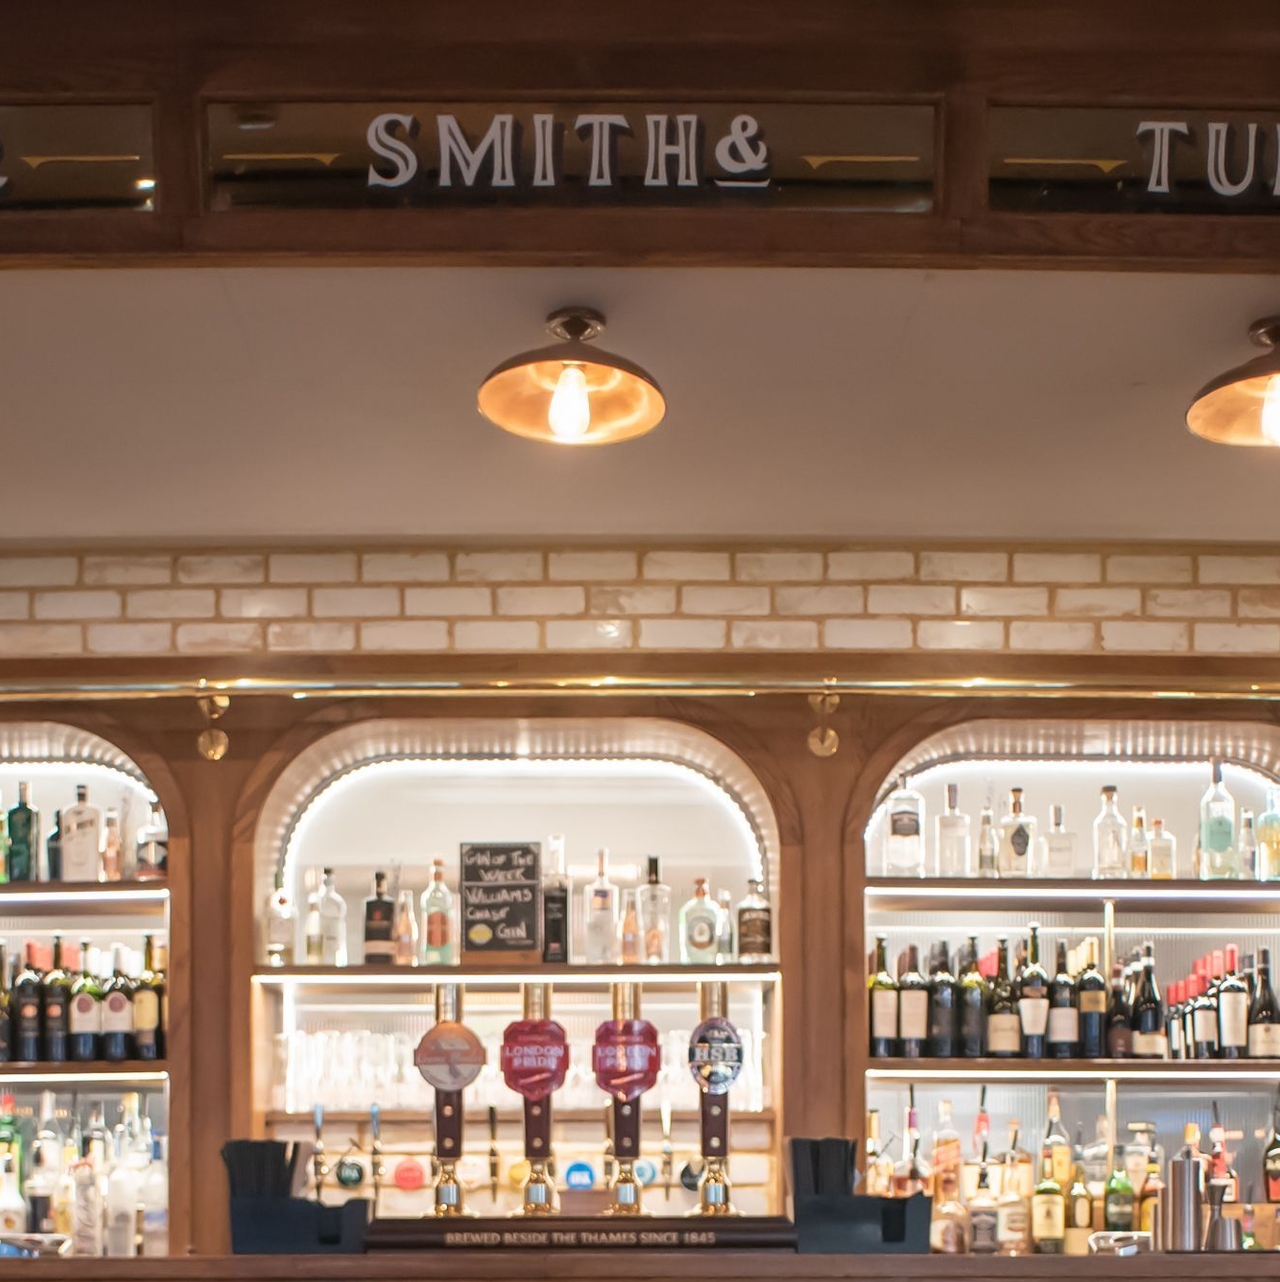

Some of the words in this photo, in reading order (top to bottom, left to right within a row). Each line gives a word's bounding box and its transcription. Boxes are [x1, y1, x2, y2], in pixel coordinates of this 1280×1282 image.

[694, 1046, 739, 1062] HSB
[445, 1232, 501, 1245] BREWED
[503, 1232, 549, 1245] BESIDE
[552, 1232, 578, 1245] THE
[580, 1232, 637, 1245] THAMES
[639, 1232, 679, 1244] SINCE
[683, 1232, 717, 1244] 1845
